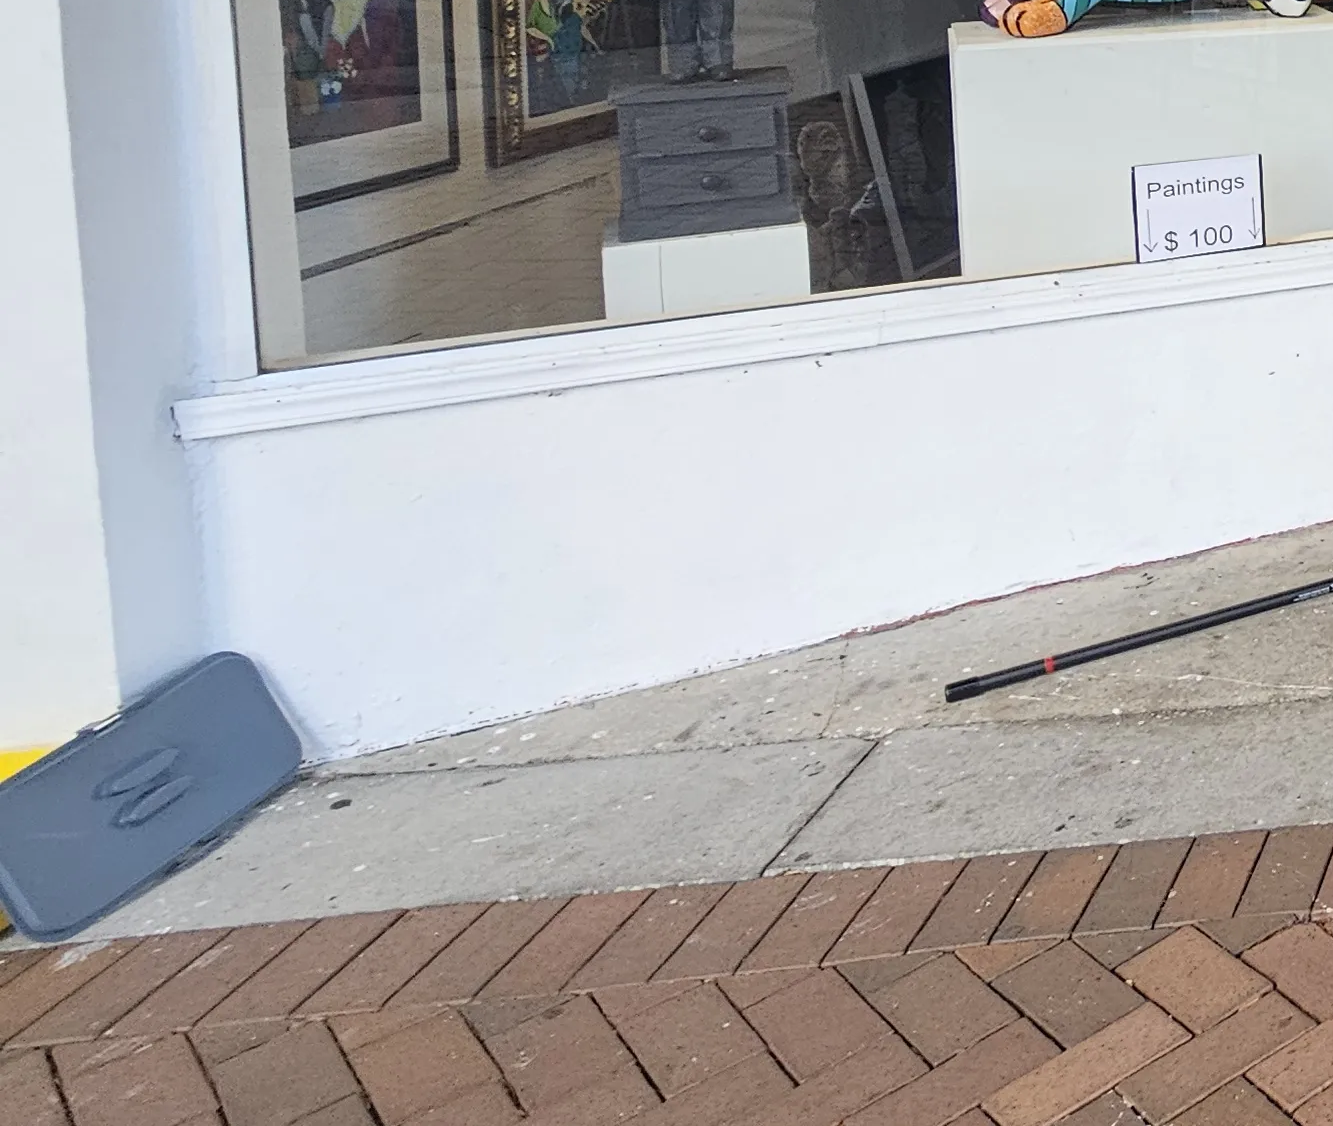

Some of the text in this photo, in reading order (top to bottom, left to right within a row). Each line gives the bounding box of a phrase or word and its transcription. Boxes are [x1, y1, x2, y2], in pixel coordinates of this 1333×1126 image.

[1147, 176, 1245, 199] Paintings
[1164, 224, 1233, 253] $ 100
